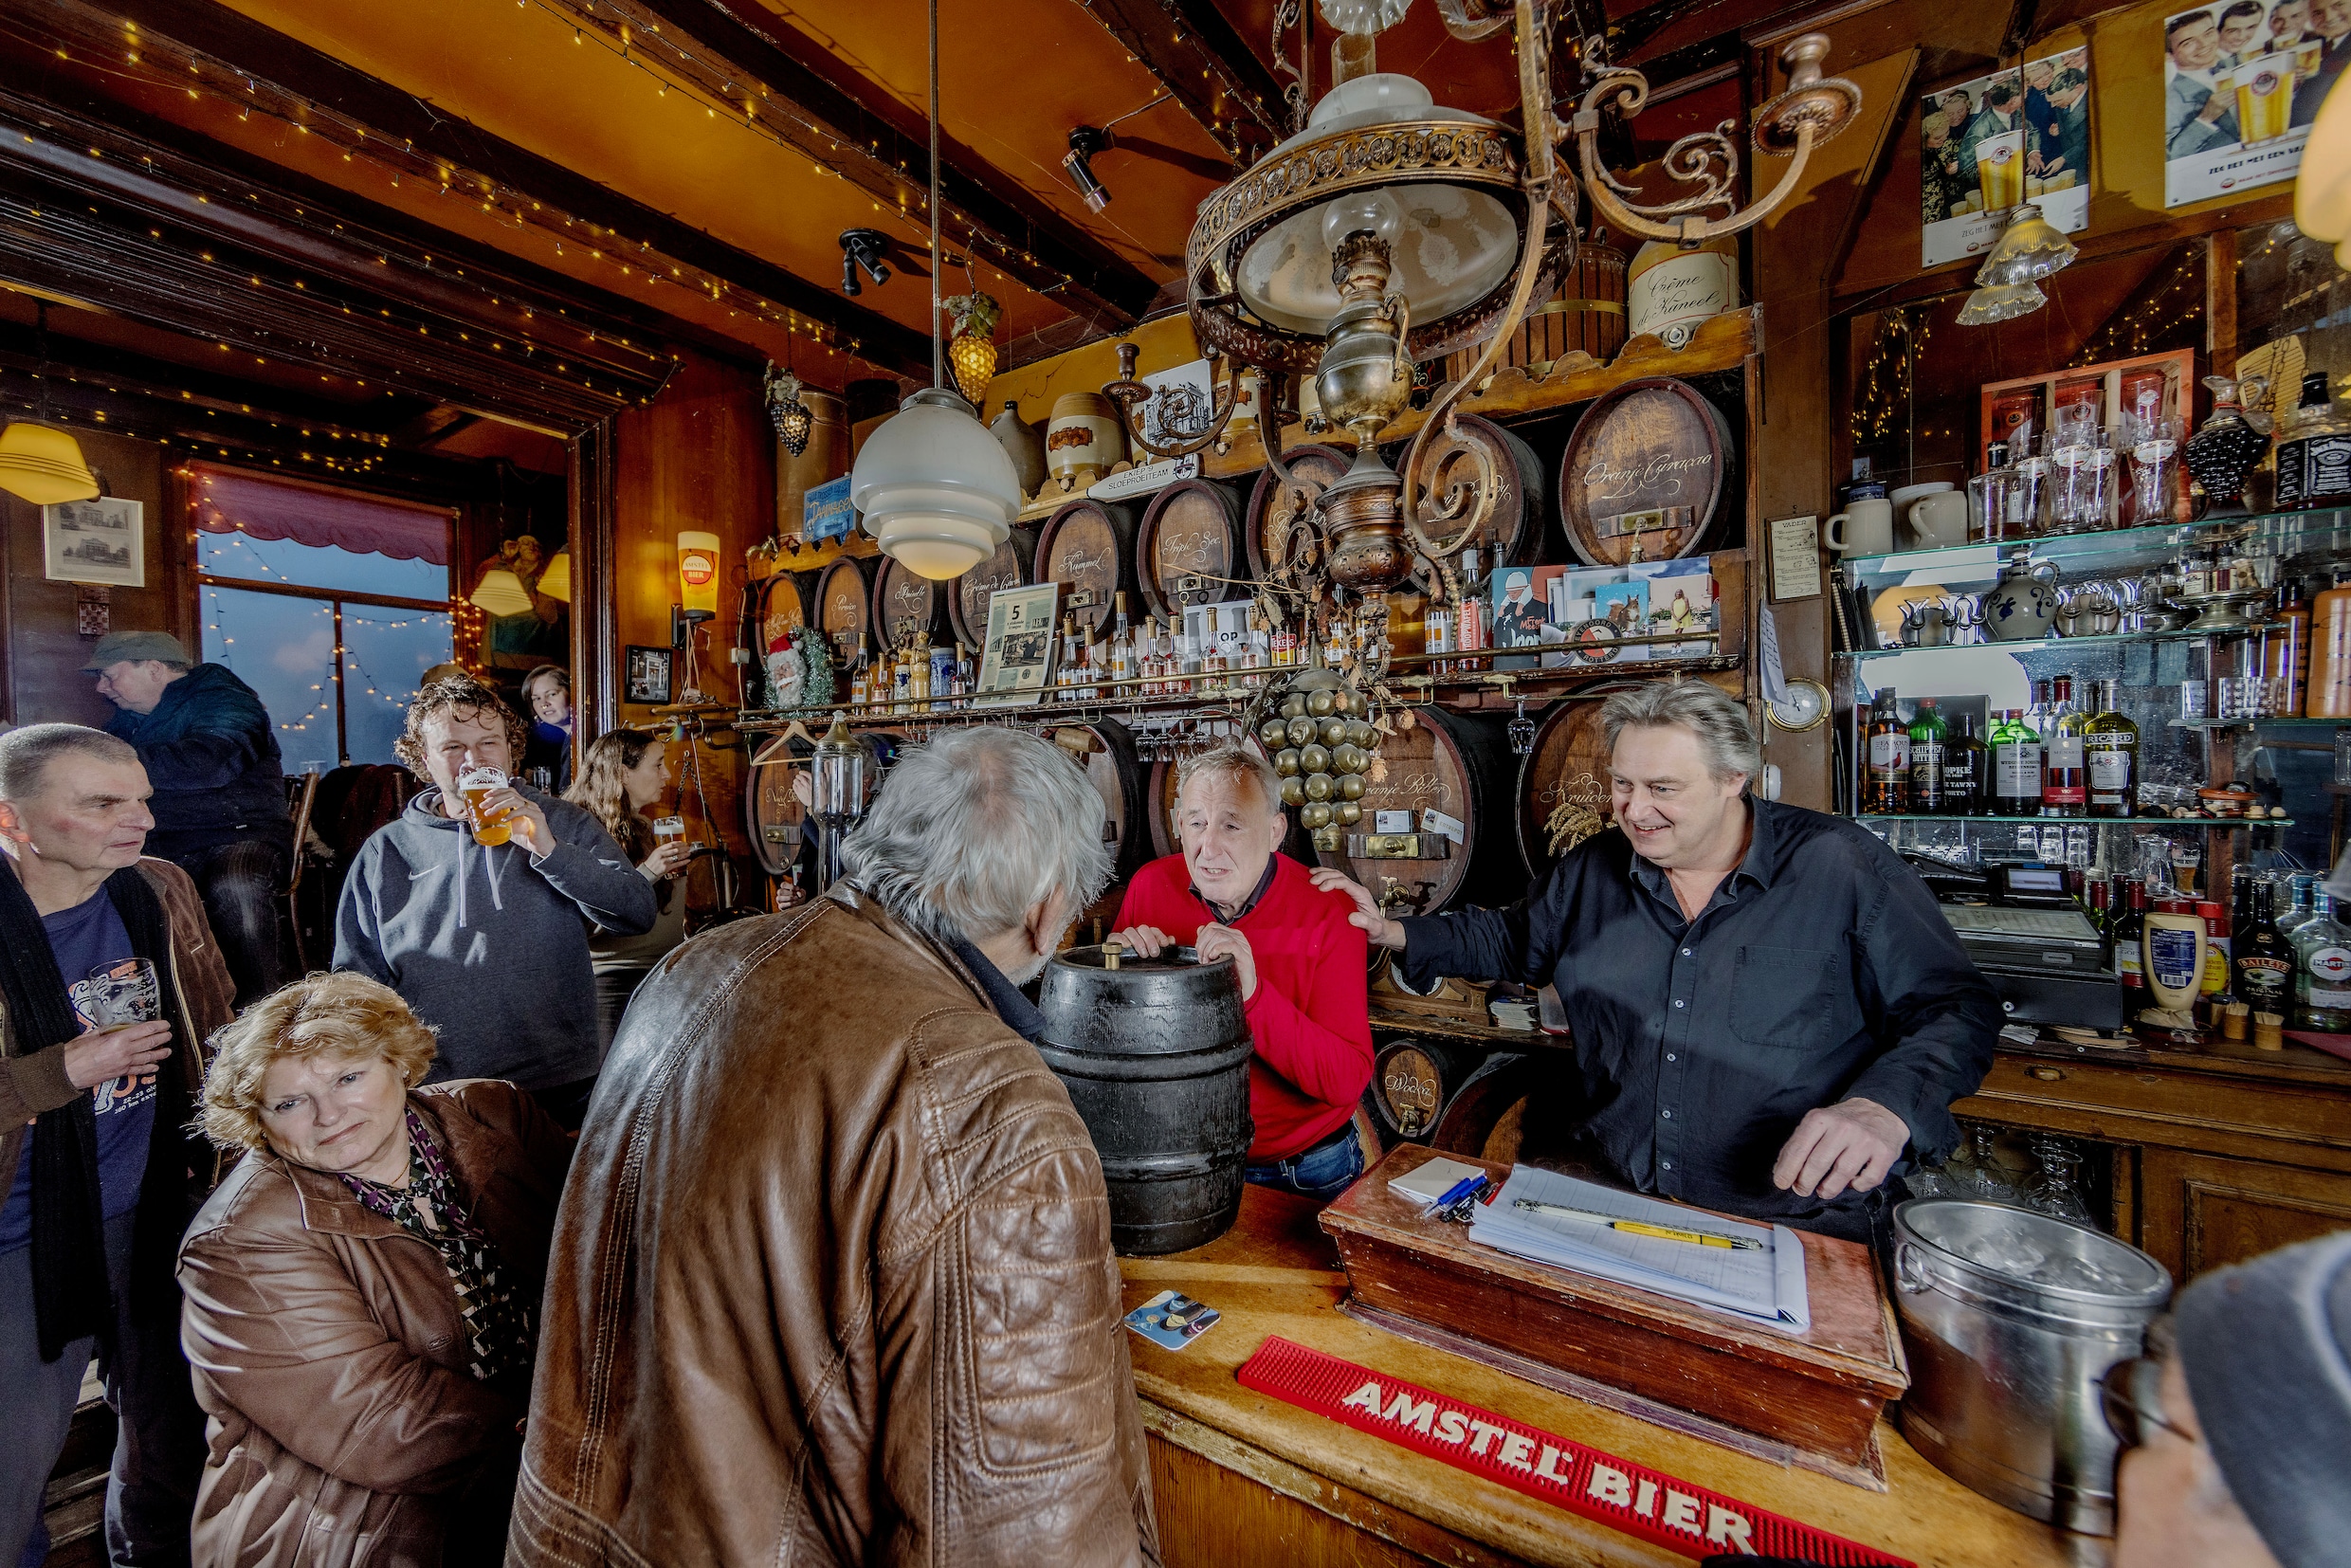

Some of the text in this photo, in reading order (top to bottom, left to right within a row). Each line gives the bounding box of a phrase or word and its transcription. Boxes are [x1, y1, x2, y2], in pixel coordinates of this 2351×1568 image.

[1108, 468, 1169, 490] SLOEPROEITEAM
[1123, 467, 1146, 479] EKIEP
[1584, 453, 1713, 495] Oranje Curaçao
[1011, 605, 1020, 620] 5
[1462, 604, 1472, 650] TROOPWAFEL
[1575, 618, 1613, 642] EYENOORD
[1220, 631, 1238, 642] OP
[2087, 734, 2131, 743] RICARD
[1912, 754, 1940, 762] BITTER
[1944, 766, 1973, 775] OPKE
[1400, 773, 1450, 801] Bitter
[2240, 957, 2290, 972] BAILEYS
[2245, 986, 2284, 994] ORIGINAL
[1587, 1461, 1759, 1557] BIER
